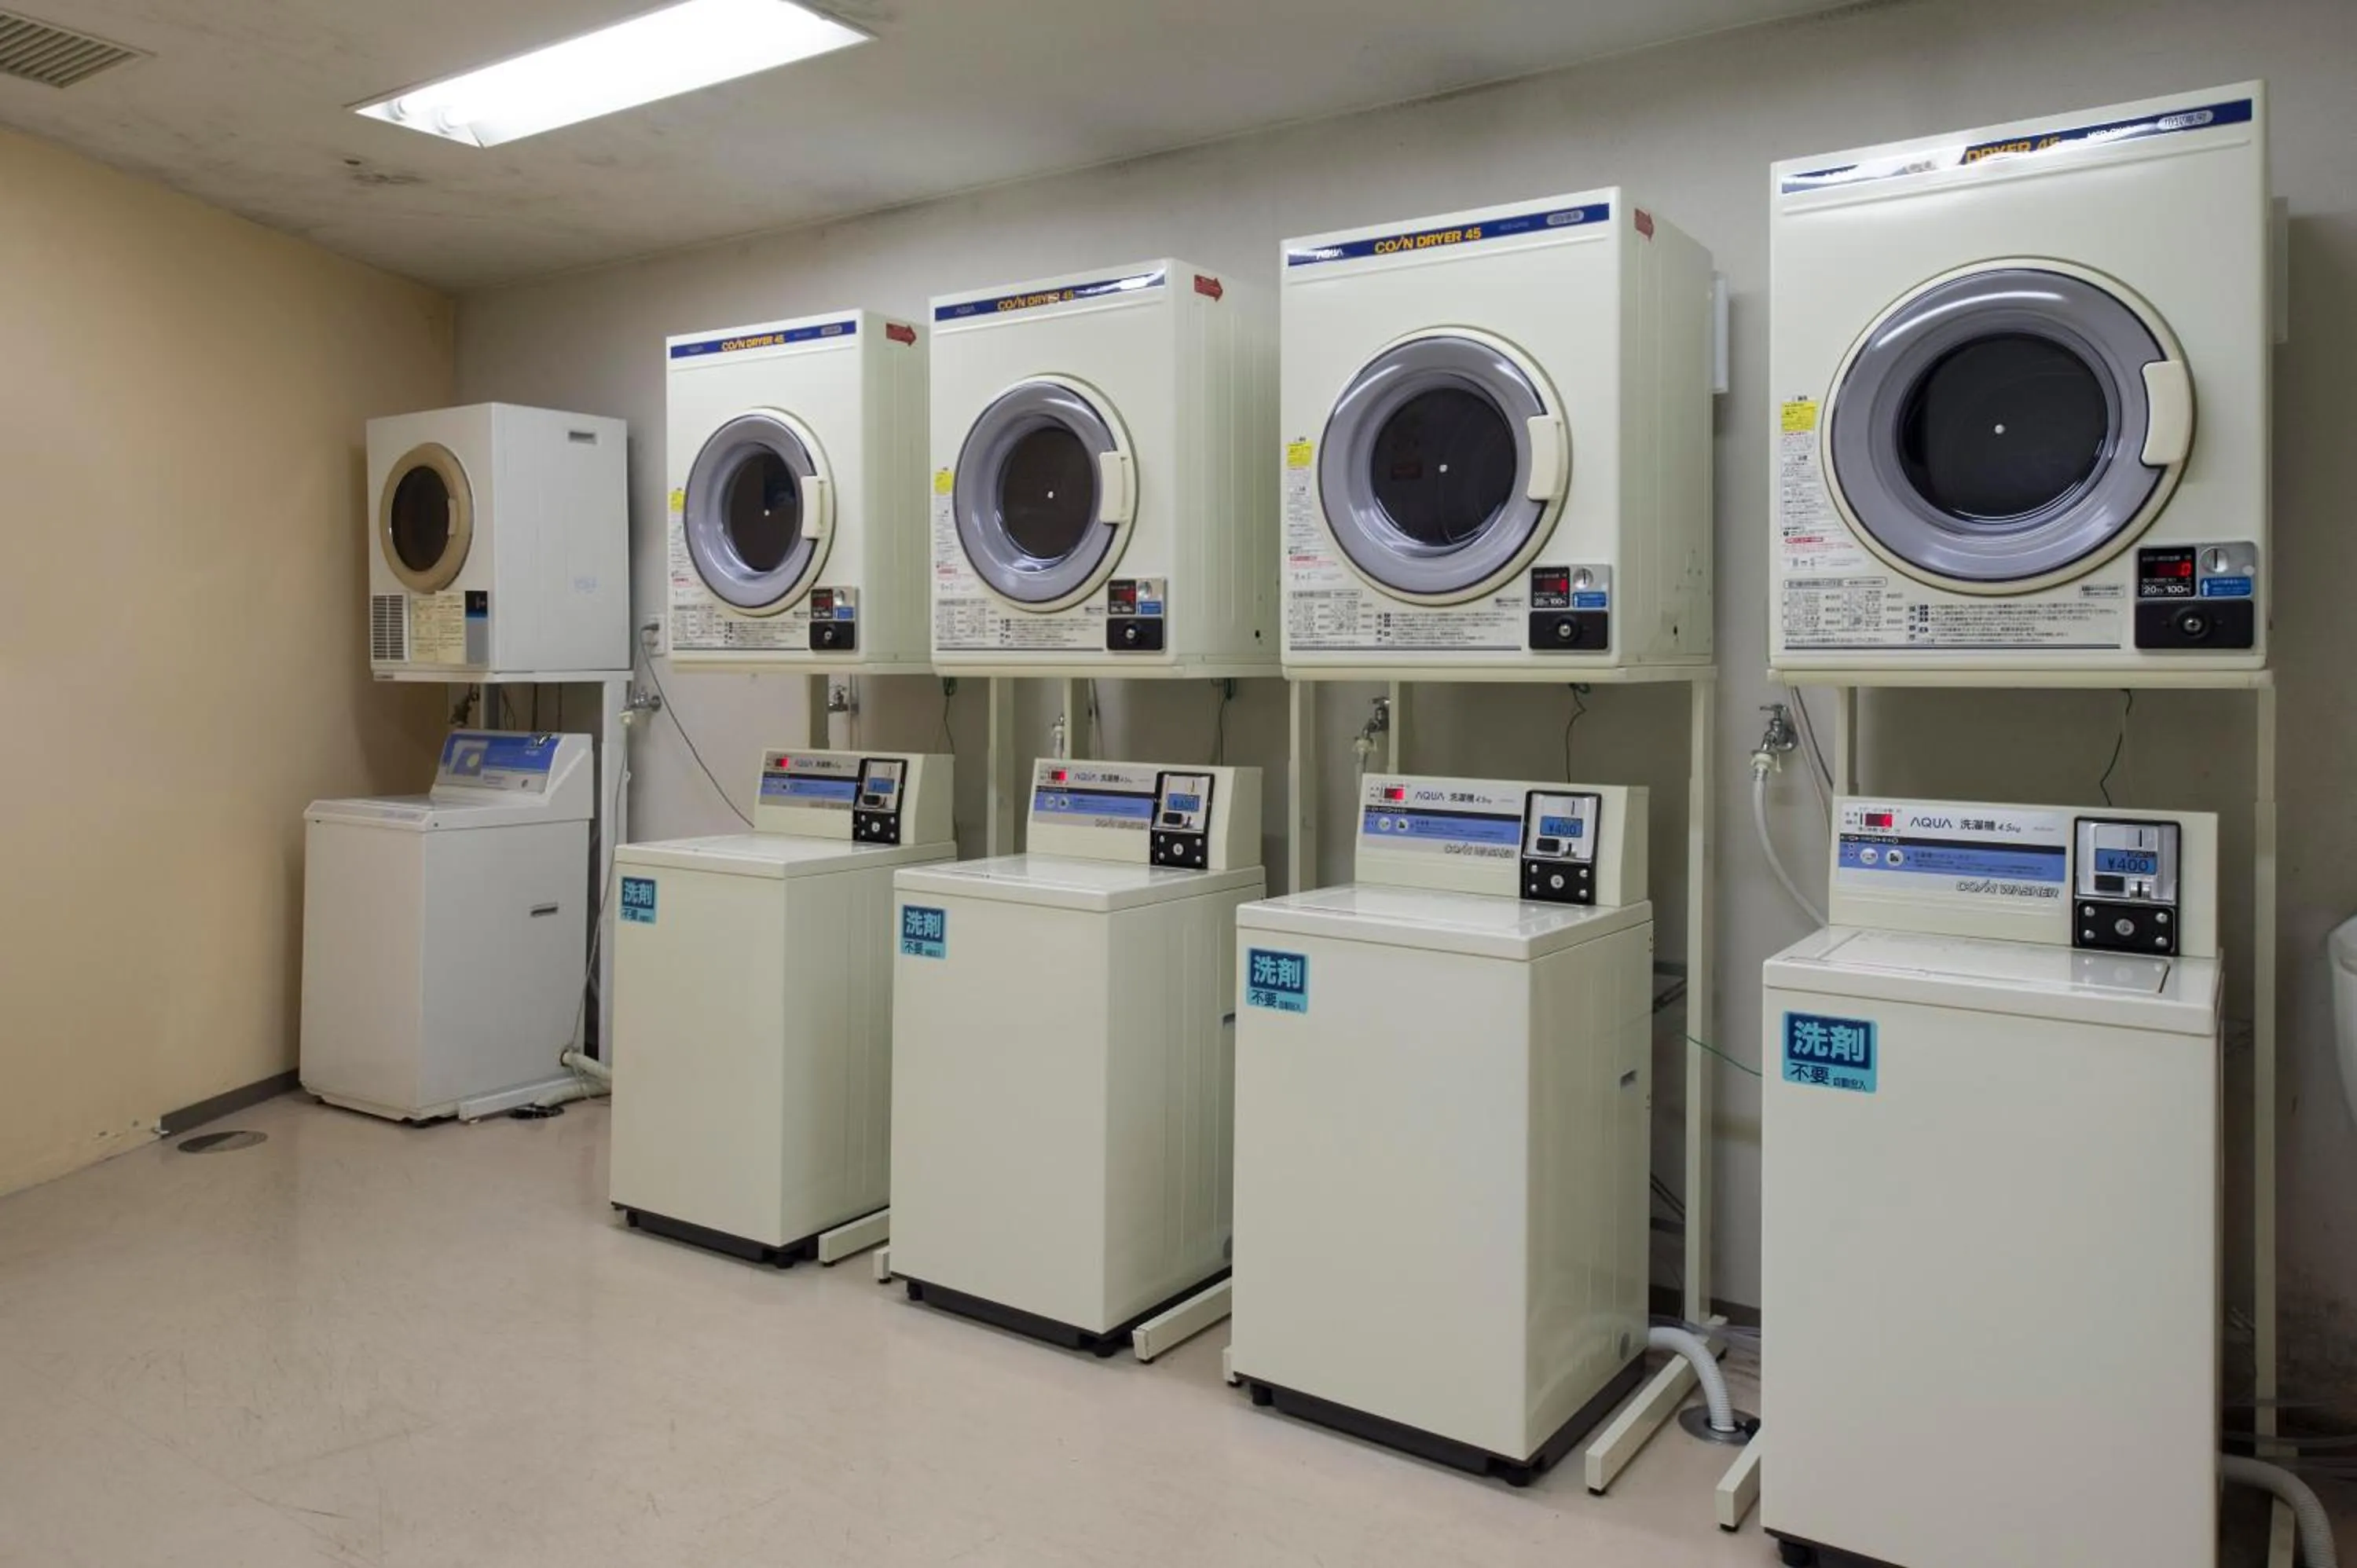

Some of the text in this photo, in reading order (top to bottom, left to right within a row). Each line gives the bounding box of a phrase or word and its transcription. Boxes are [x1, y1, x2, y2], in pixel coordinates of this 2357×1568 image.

[1417, 231, 1462, 248] DRYER
[1464, 227, 1482, 240] 45
[1415, 790, 1446, 801] AQUA
[1910, 816, 1953, 830] AQUA
[1960, 819, 1996, 832] 洗濯機
[2107, 856, 2150, 872] ¥400
[624, 880, 653, 906] 洗剤
[906, 910, 941, 939] 洗剤
[1253, 954, 1302, 989] 洗剤
[1250, 989, 1277, 1009] 不要
[1792, 1020, 1865, 1063] 洗剤
[1791, 1063, 1830, 1086] 不要
